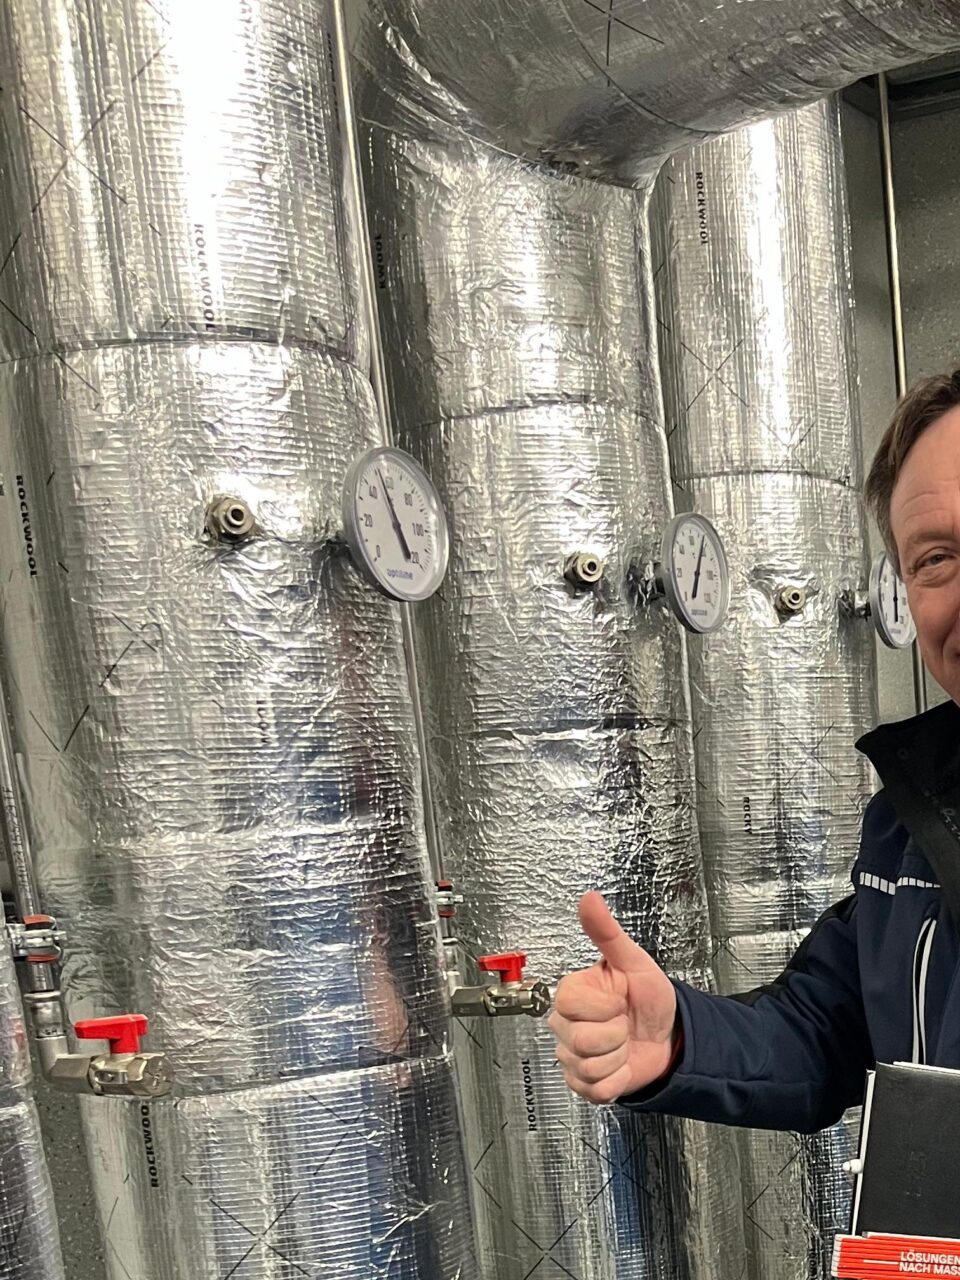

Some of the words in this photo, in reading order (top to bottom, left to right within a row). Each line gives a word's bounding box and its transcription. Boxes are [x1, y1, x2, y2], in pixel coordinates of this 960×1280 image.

[696, 172, 709, 245] ROCKWOOL
[194, 223, 216, 331] ROCKWOOL
[16, 475, 37, 576] ROCKWOOL
[521, 1058, 538, 1132] ROCKWOOL
[141, 1105, 159, 1187] ROCKWOO
[899, 1262, 931, 1274] NACH
